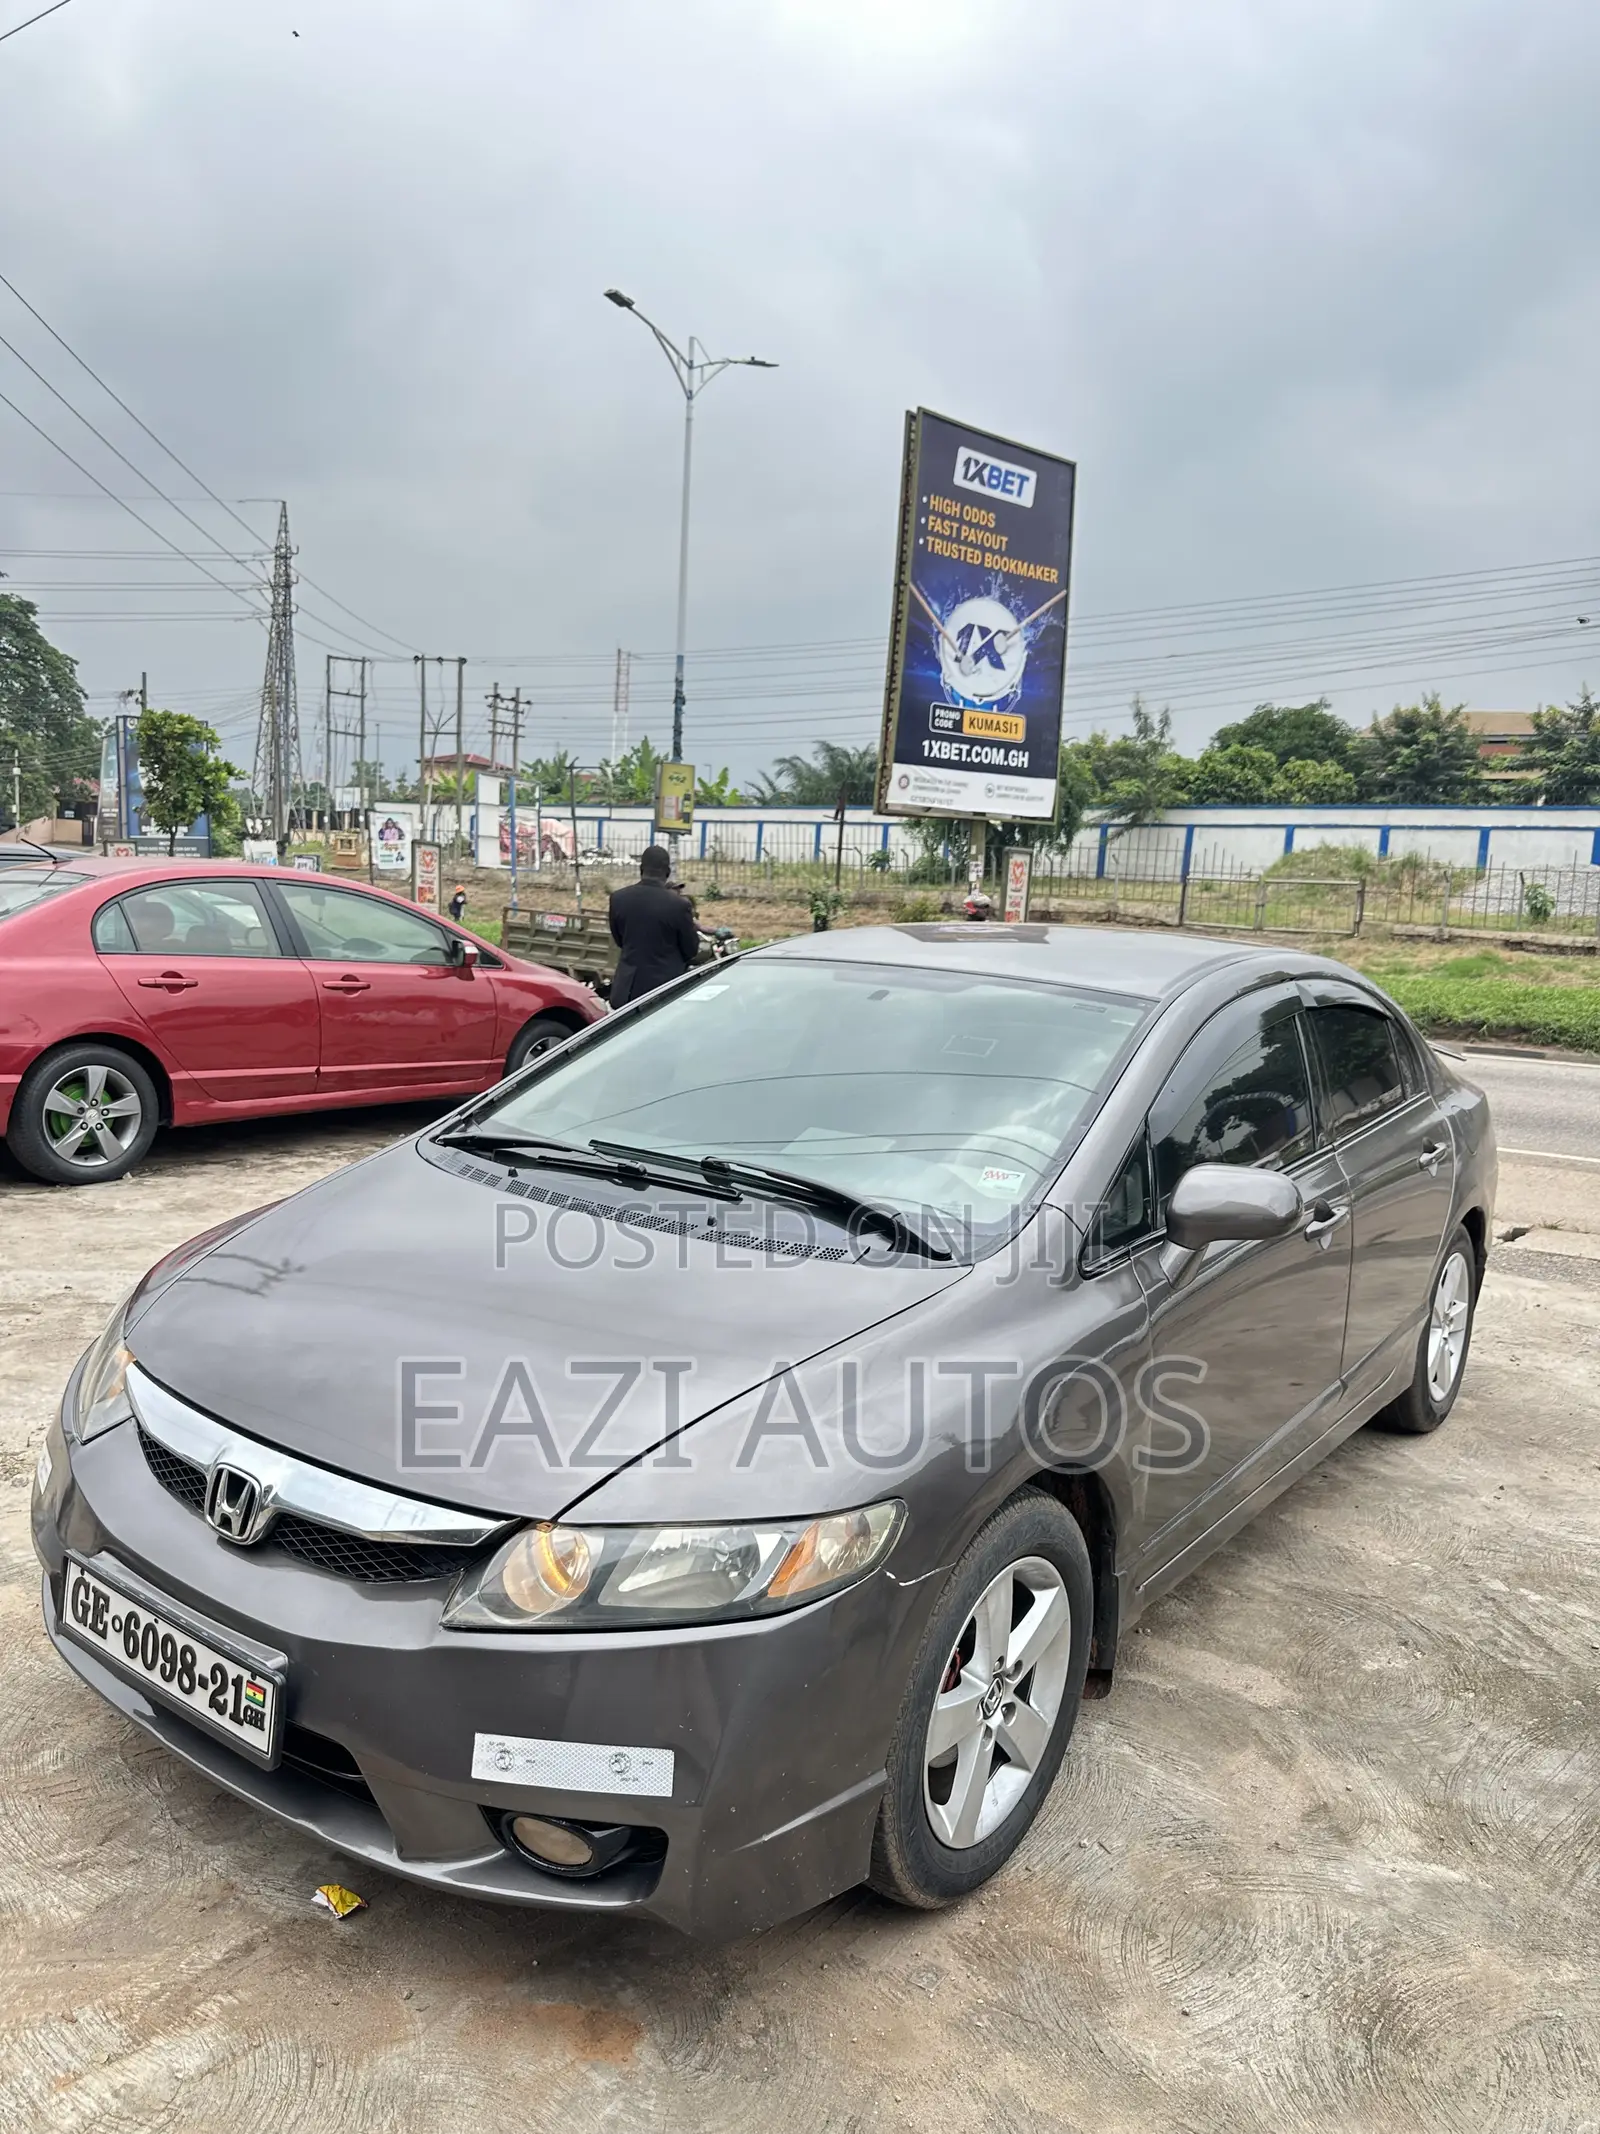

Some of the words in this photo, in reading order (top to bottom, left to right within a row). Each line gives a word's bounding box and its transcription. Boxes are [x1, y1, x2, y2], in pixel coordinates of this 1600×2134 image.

[963, 457, 1030, 498] 1XBET
[930, 495, 961, 518] HIGH
[963, 504, 996, 528] ODDS
[927, 515, 959, 538] FAST
[961, 524, 1008, 552] PAYOUT
[926, 536, 982, 565] TRUSTED
[984, 552, 1059, 584] BOOKMAKER
[934, 718, 954, 729] CODE
[935, 708, 961, 721] PROMO
[968, 717, 1019, 734] KUMASI1
[922, 740, 1030, 768] 1XBET.COM.GH
